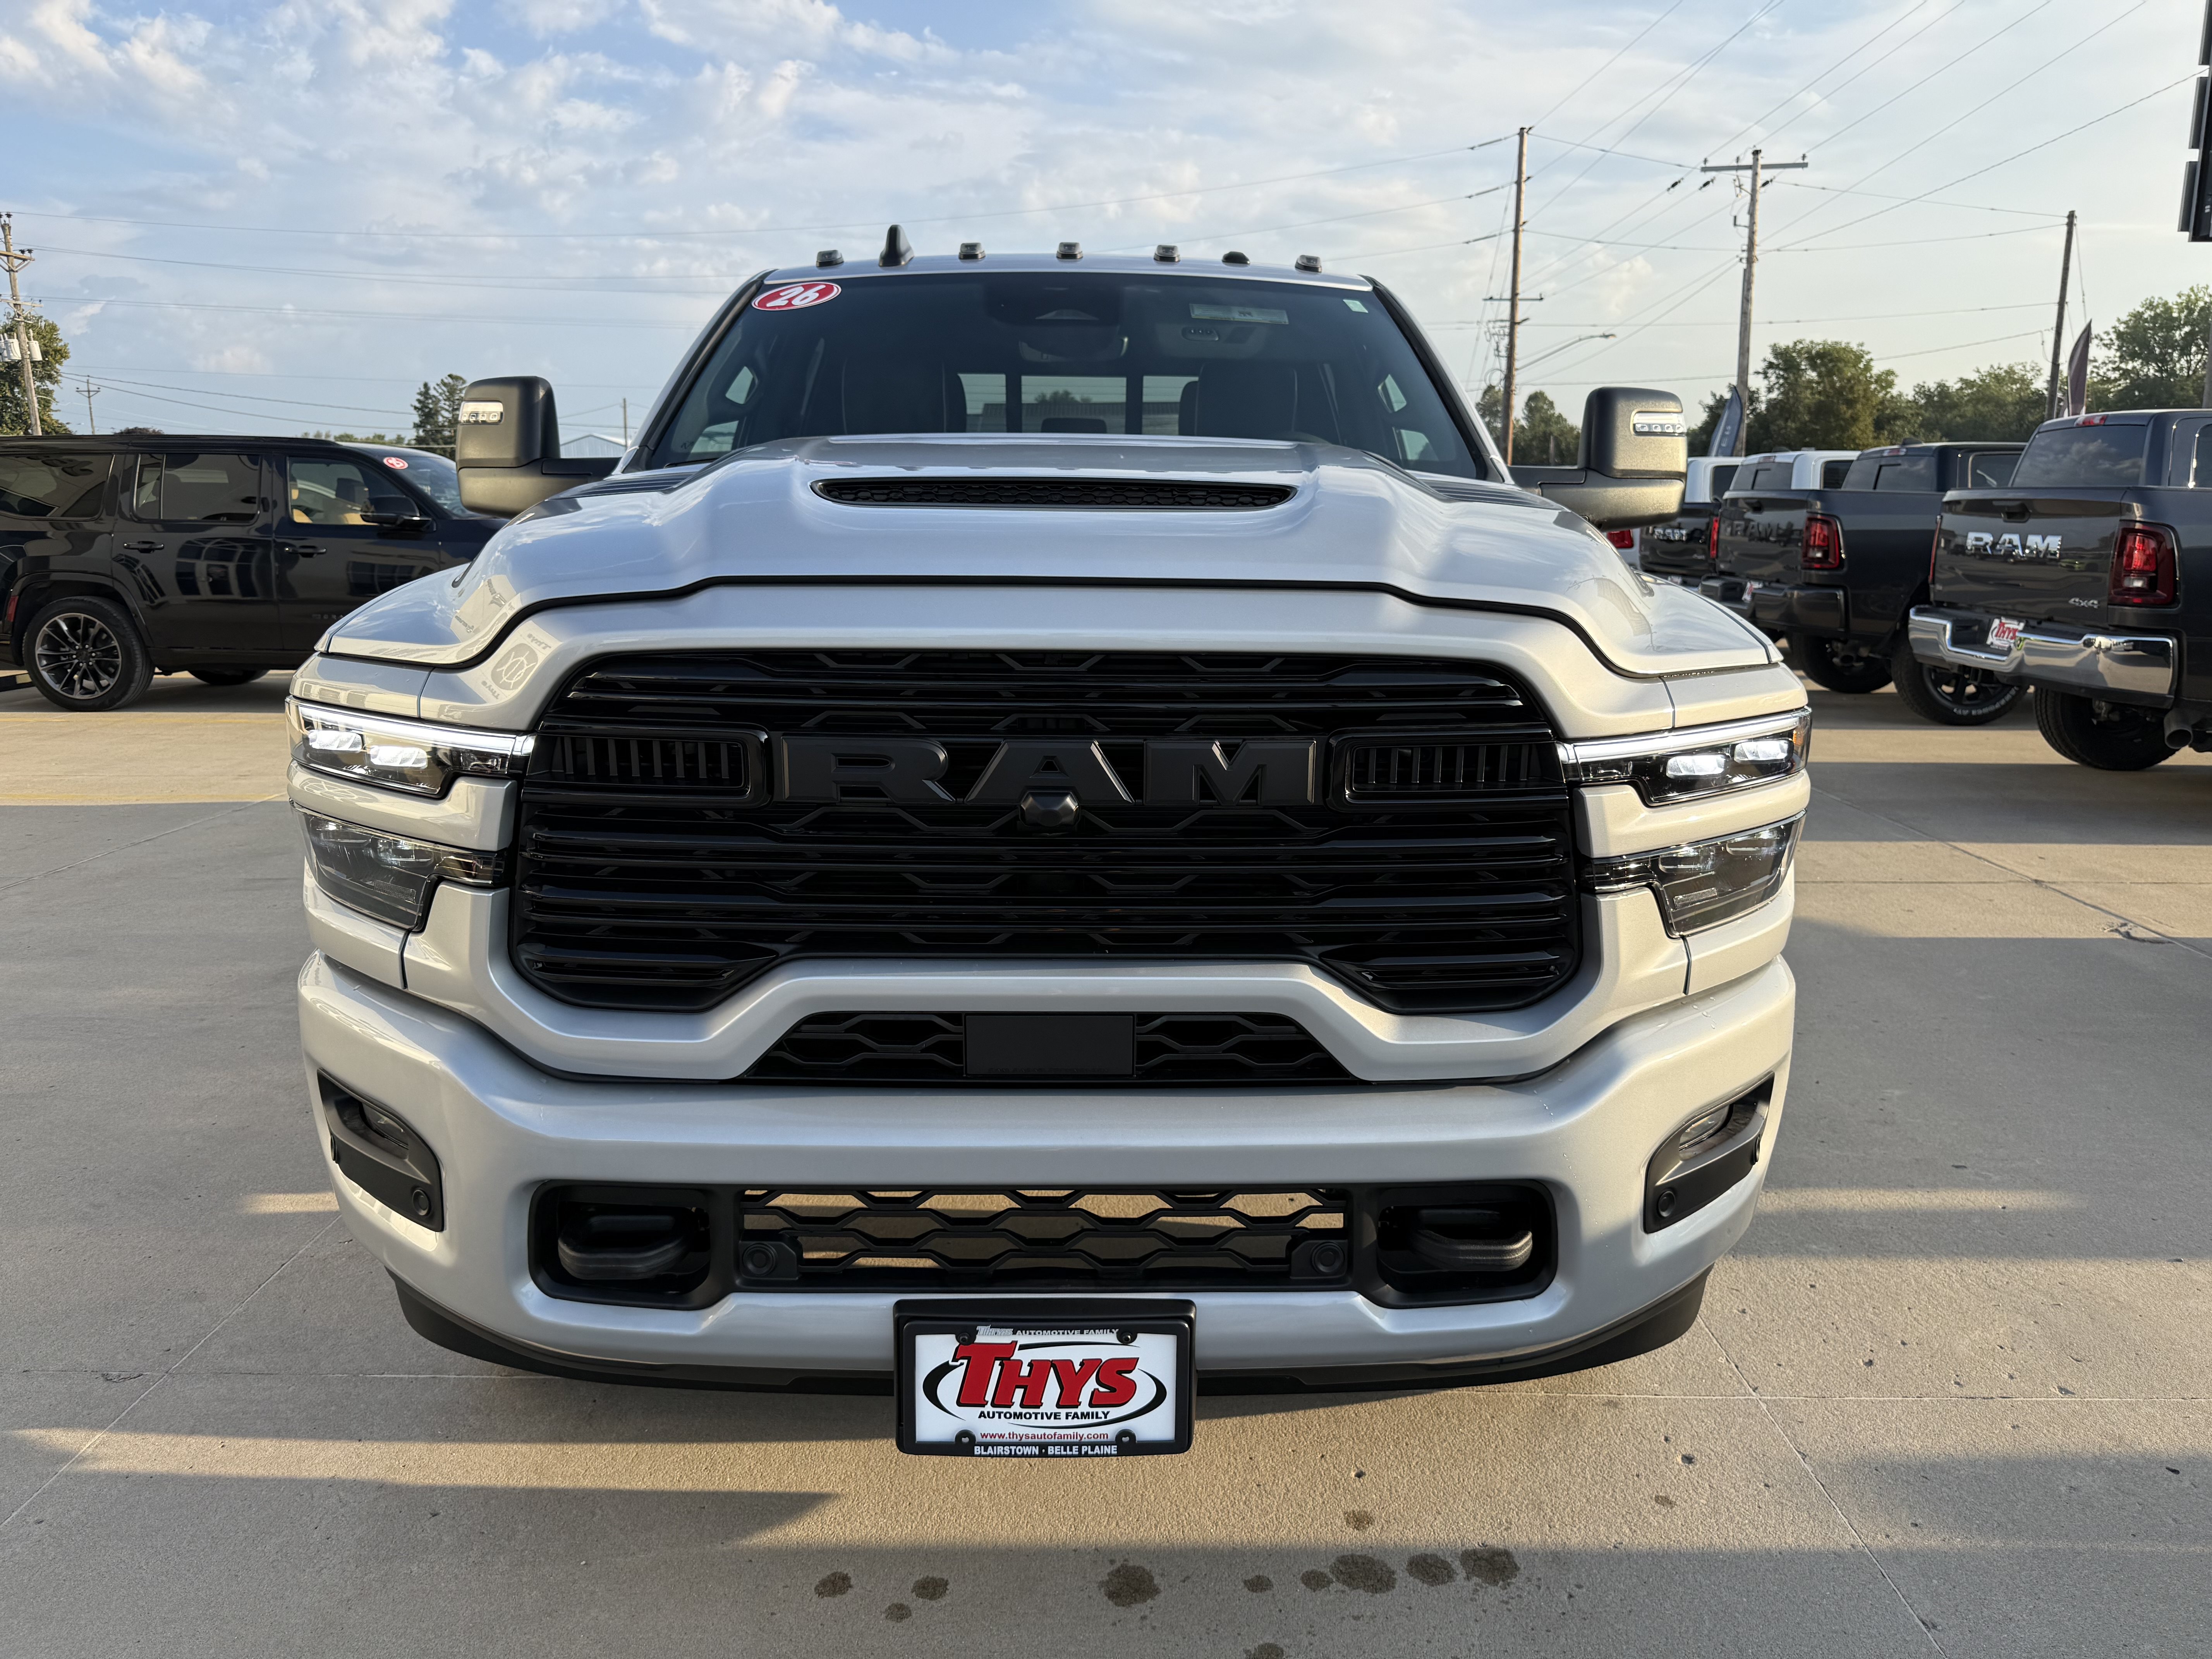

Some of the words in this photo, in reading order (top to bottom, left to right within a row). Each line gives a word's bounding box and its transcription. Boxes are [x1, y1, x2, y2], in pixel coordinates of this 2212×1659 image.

[766, 285, 826, 307] 26
[1966, 532, 2062, 558] RAM
[781, 735, 1316, 805] RAM
[951, 1341, 1139, 1408] THYS
[978, 1411, 1061, 1420] AUTOMOTIVE
[1065, 1411, 1110, 1420] FAMILY
[980, 1431, 1109, 1441] www.thysautofamily.com
[974, 1446, 1039, 1455] BLAIRSTOWN
[1048, 1445, 1079, 1455] BELLE
[1082, 1445, 1117, 1455] PLAINE
